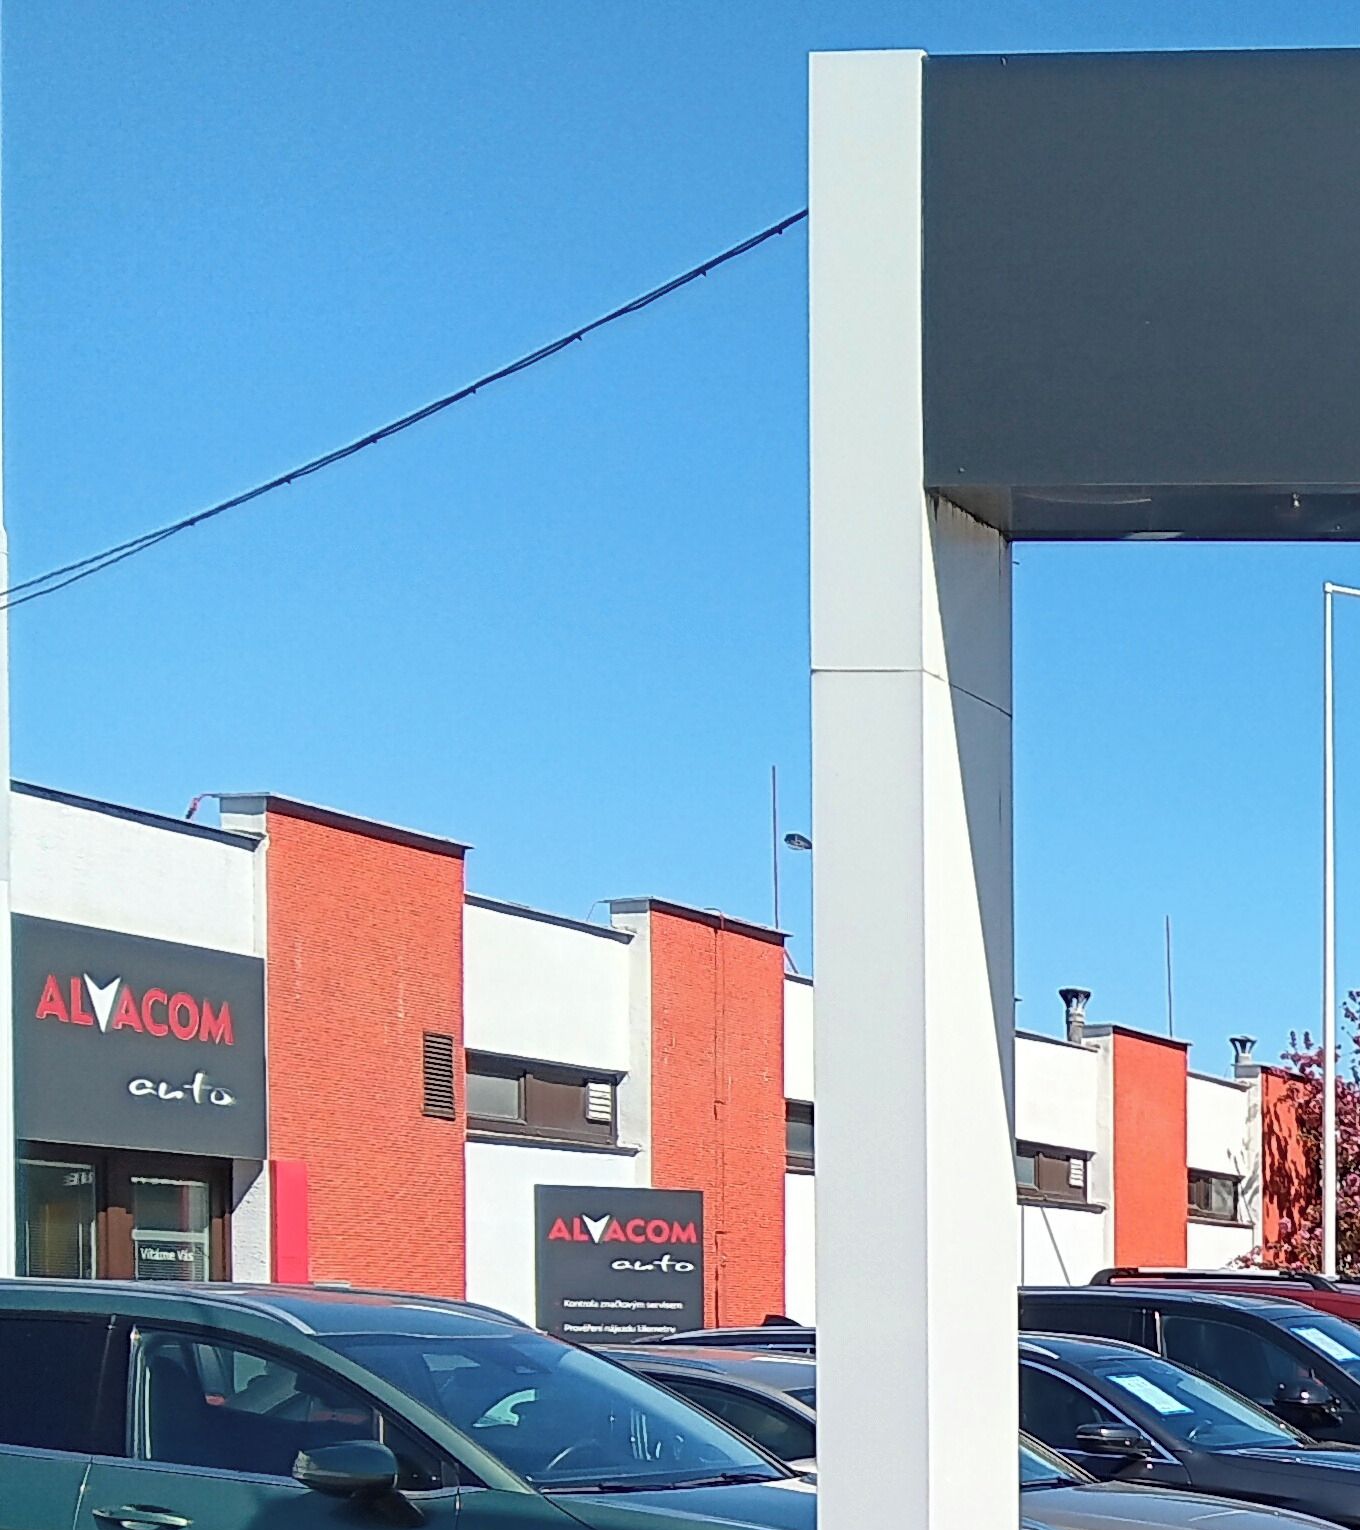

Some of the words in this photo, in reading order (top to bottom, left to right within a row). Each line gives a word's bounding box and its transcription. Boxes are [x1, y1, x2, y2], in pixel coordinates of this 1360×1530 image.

[36, 973, 234, 1046] ALVACOM
[128, 1071, 237, 1106] auto
[548, 1214, 698, 1244] ALVACOM
[611, 1254, 695, 1273] auto
